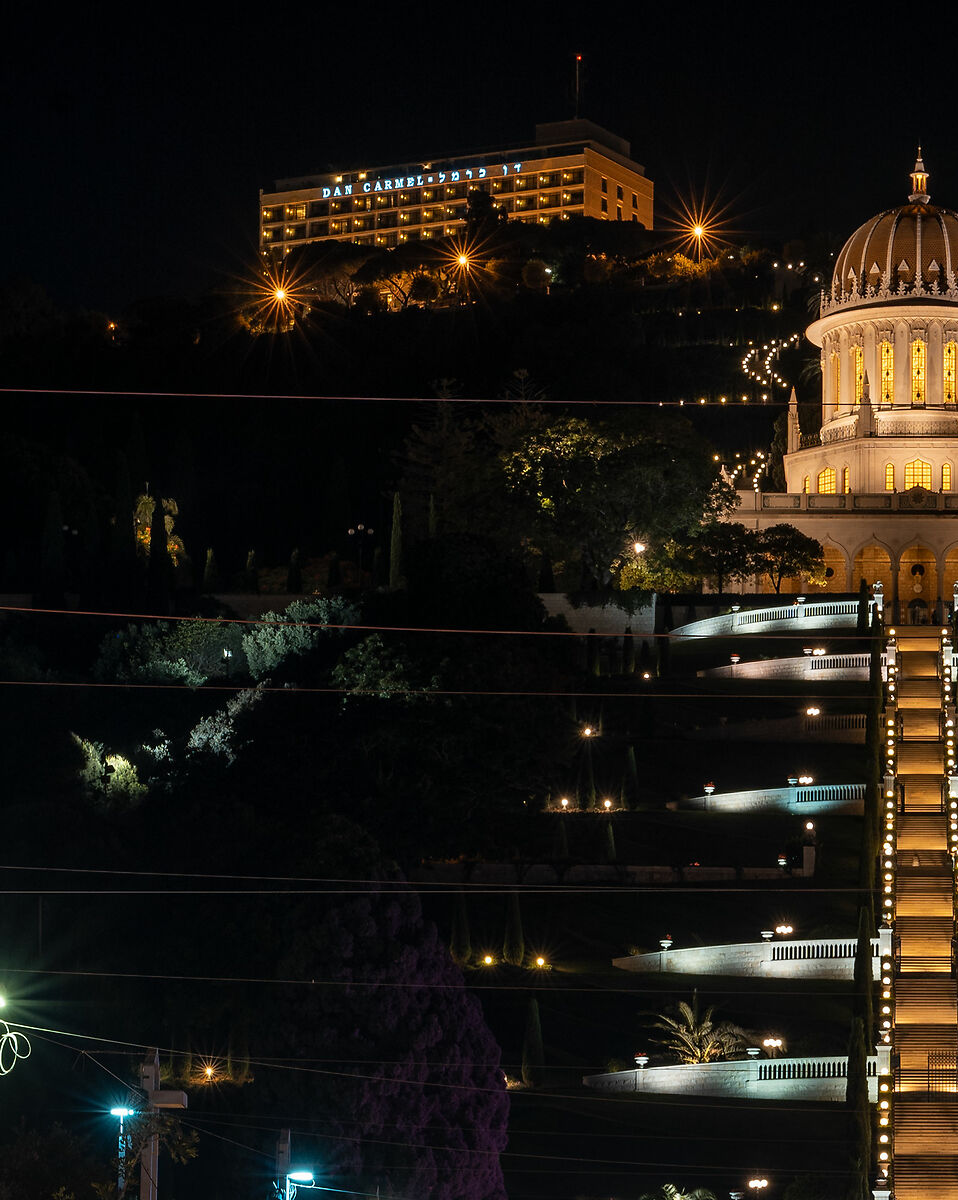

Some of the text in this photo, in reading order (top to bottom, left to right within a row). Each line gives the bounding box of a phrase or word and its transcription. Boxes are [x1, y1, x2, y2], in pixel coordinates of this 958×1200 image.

[438, 167, 487, 183] כרמל
[322, 175, 424, 198] DAN CARMEL
